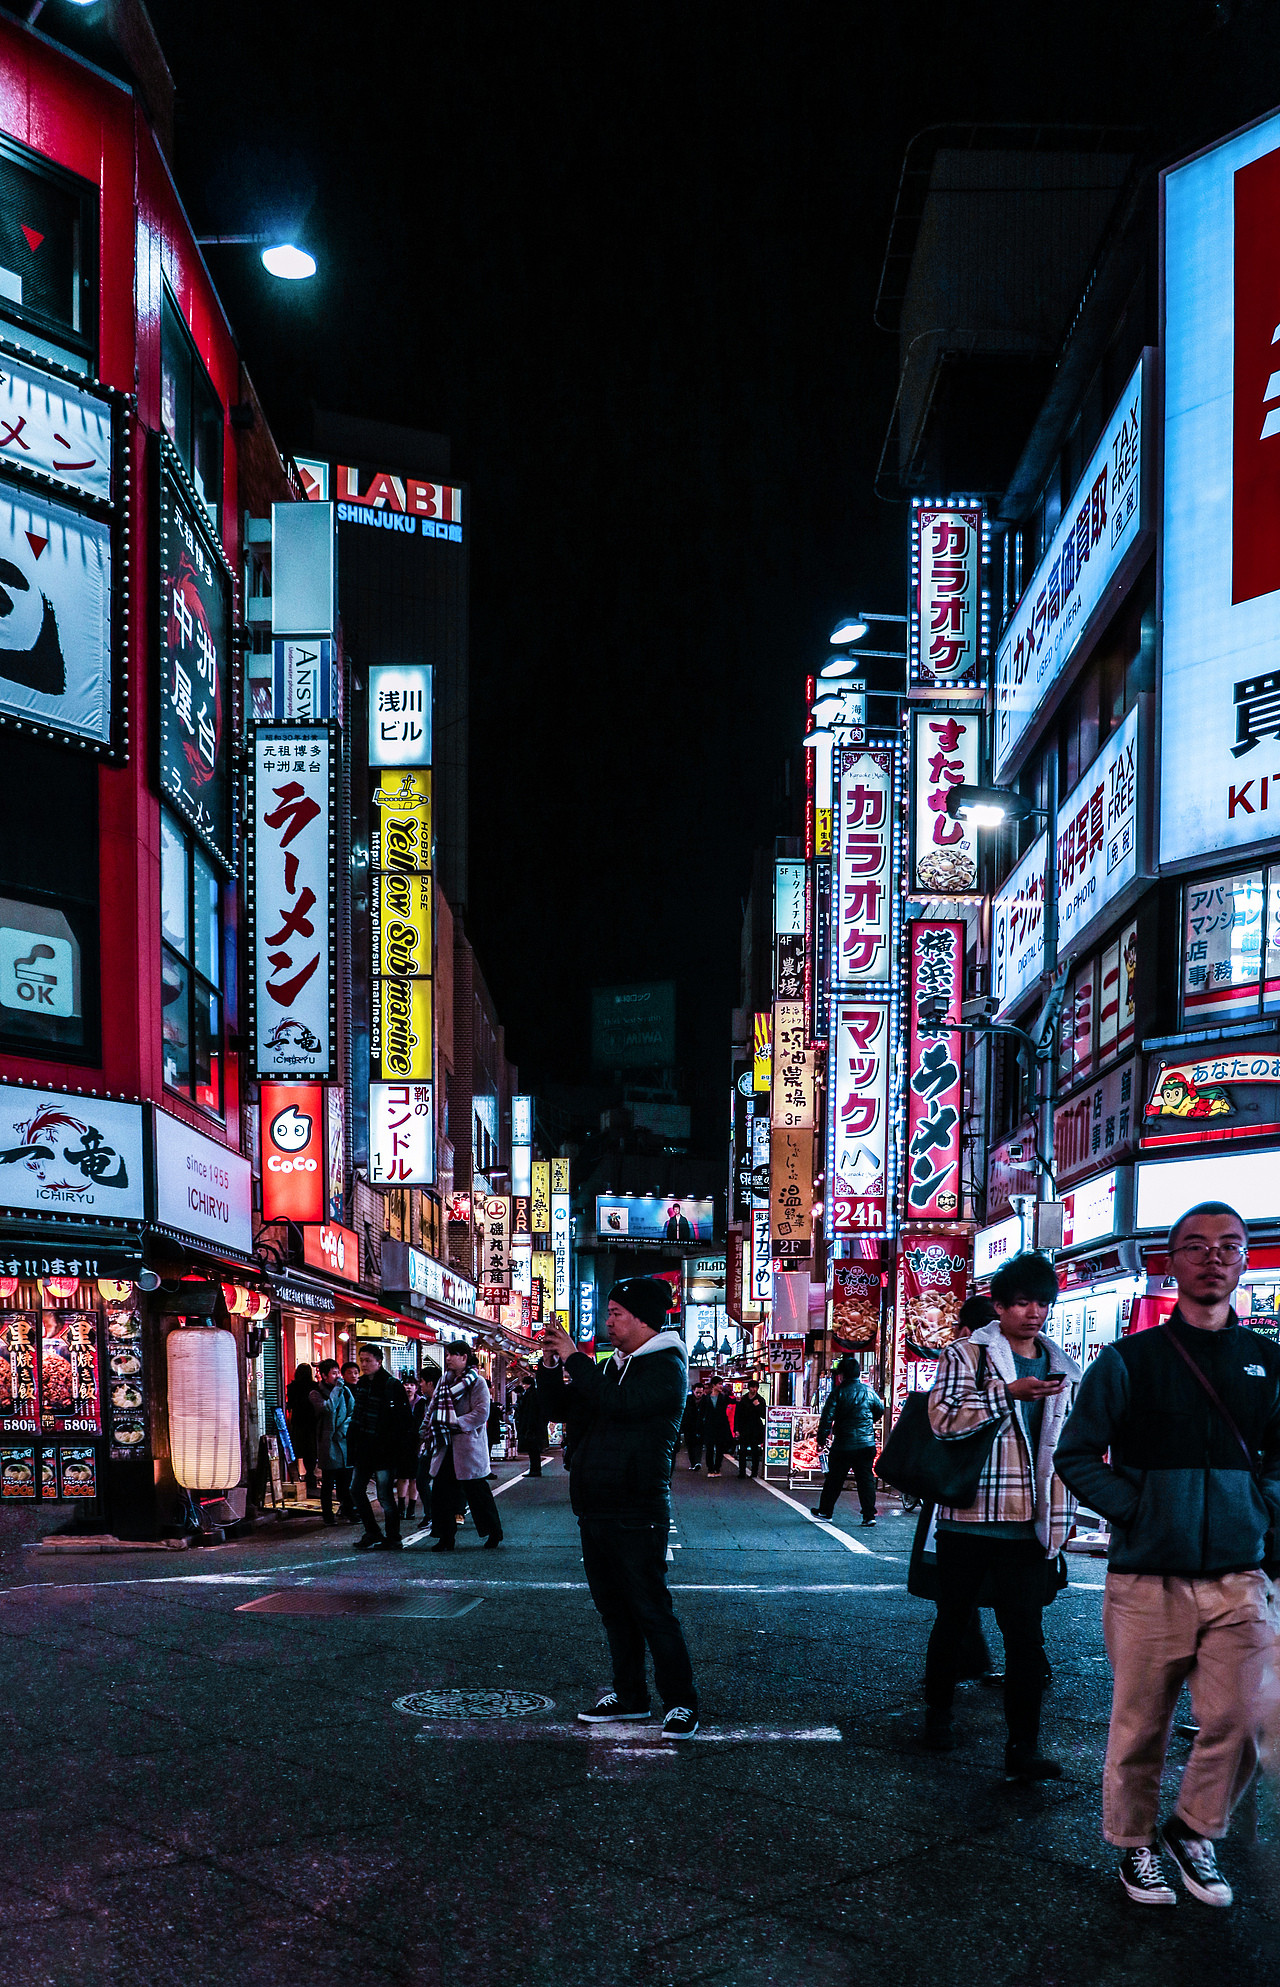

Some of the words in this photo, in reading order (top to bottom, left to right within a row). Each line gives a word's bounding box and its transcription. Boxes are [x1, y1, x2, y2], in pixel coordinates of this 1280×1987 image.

[1112, 395, 1139, 460] TAX
[1111, 430, 1139, 507] FREE
[337, 464, 461, 523] LABI
[337, 503, 416, 534] SHINJUKU
[1012, 462, 1108, 698] カメラ高価買取
[929, 520, 970, 674] カラオケ
[1036, 643, 1053, 684] USED
[1055, 594, 1083, 661] CAMERA
[378, 689, 422, 712] 浅川
[380, 720, 423, 741] ビル
[263, 743, 322, 757] 元祖博多
[1109, 738, 1135, 790] TAX
[263, 760, 321, 773] 中洲屋台
[1108, 771, 1135, 832] FREE
[419, 822, 431, 868] HOBBY
[386, 817, 418, 917] Yellow
[780, 867, 789, 875] 5F
[844, 783, 888, 975] カラオケ
[262, 780, 322, 1008] ラーメン
[419, 875, 431, 912] BASE
[1072, 877, 1096, 917] PHOTO
[1191, 880, 1262, 911] アパート
[1190, 910, 1261, 935] マンション
[780, 936, 792, 946] 4F
[997, 915, 1006, 993] 3F
[1188, 955, 1261, 987] 事務所
[17, 982, 55, 1006] OK
[273, 1056, 316, 1067] ICHIRYU
[841, 1010, 884, 1138] マック
[413, 1087, 430, 1117] 靴の
[387, 1086, 413, 1182] コンドル
[784, 1112, 803, 1126] 3F
[186, 1153, 207, 1178] since
[209, 1163, 229, 1189] 1955
[267, 1154, 318, 1173] CoCo
[373, 1152, 385, 1182] 1F
[36, 1189, 95, 1205] ICHIRYU
[187, 1186, 229, 1224] ICHIRYU
[516, 1199, 528, 1232] BAR
[835, 1200, 884, 1228] 24h
[755, 1222, 771, 1297] チカラめし
[780, 1241, 803, 1254] 2F
[905, 1247, 966, 1273] すためし
[834, 1266, 880, 1286] すためし
[7, 1319, 36, 1400] 黒焼き飯
[67, 1319, 97, 1400] 黒焼き飯
[770, 1350, 802, 1361] チカラ
[783, 1361, 802, 1371] めし
[3, 1419, 37, 1432] 580円
[63, 1419, 97, 1432] 580円
